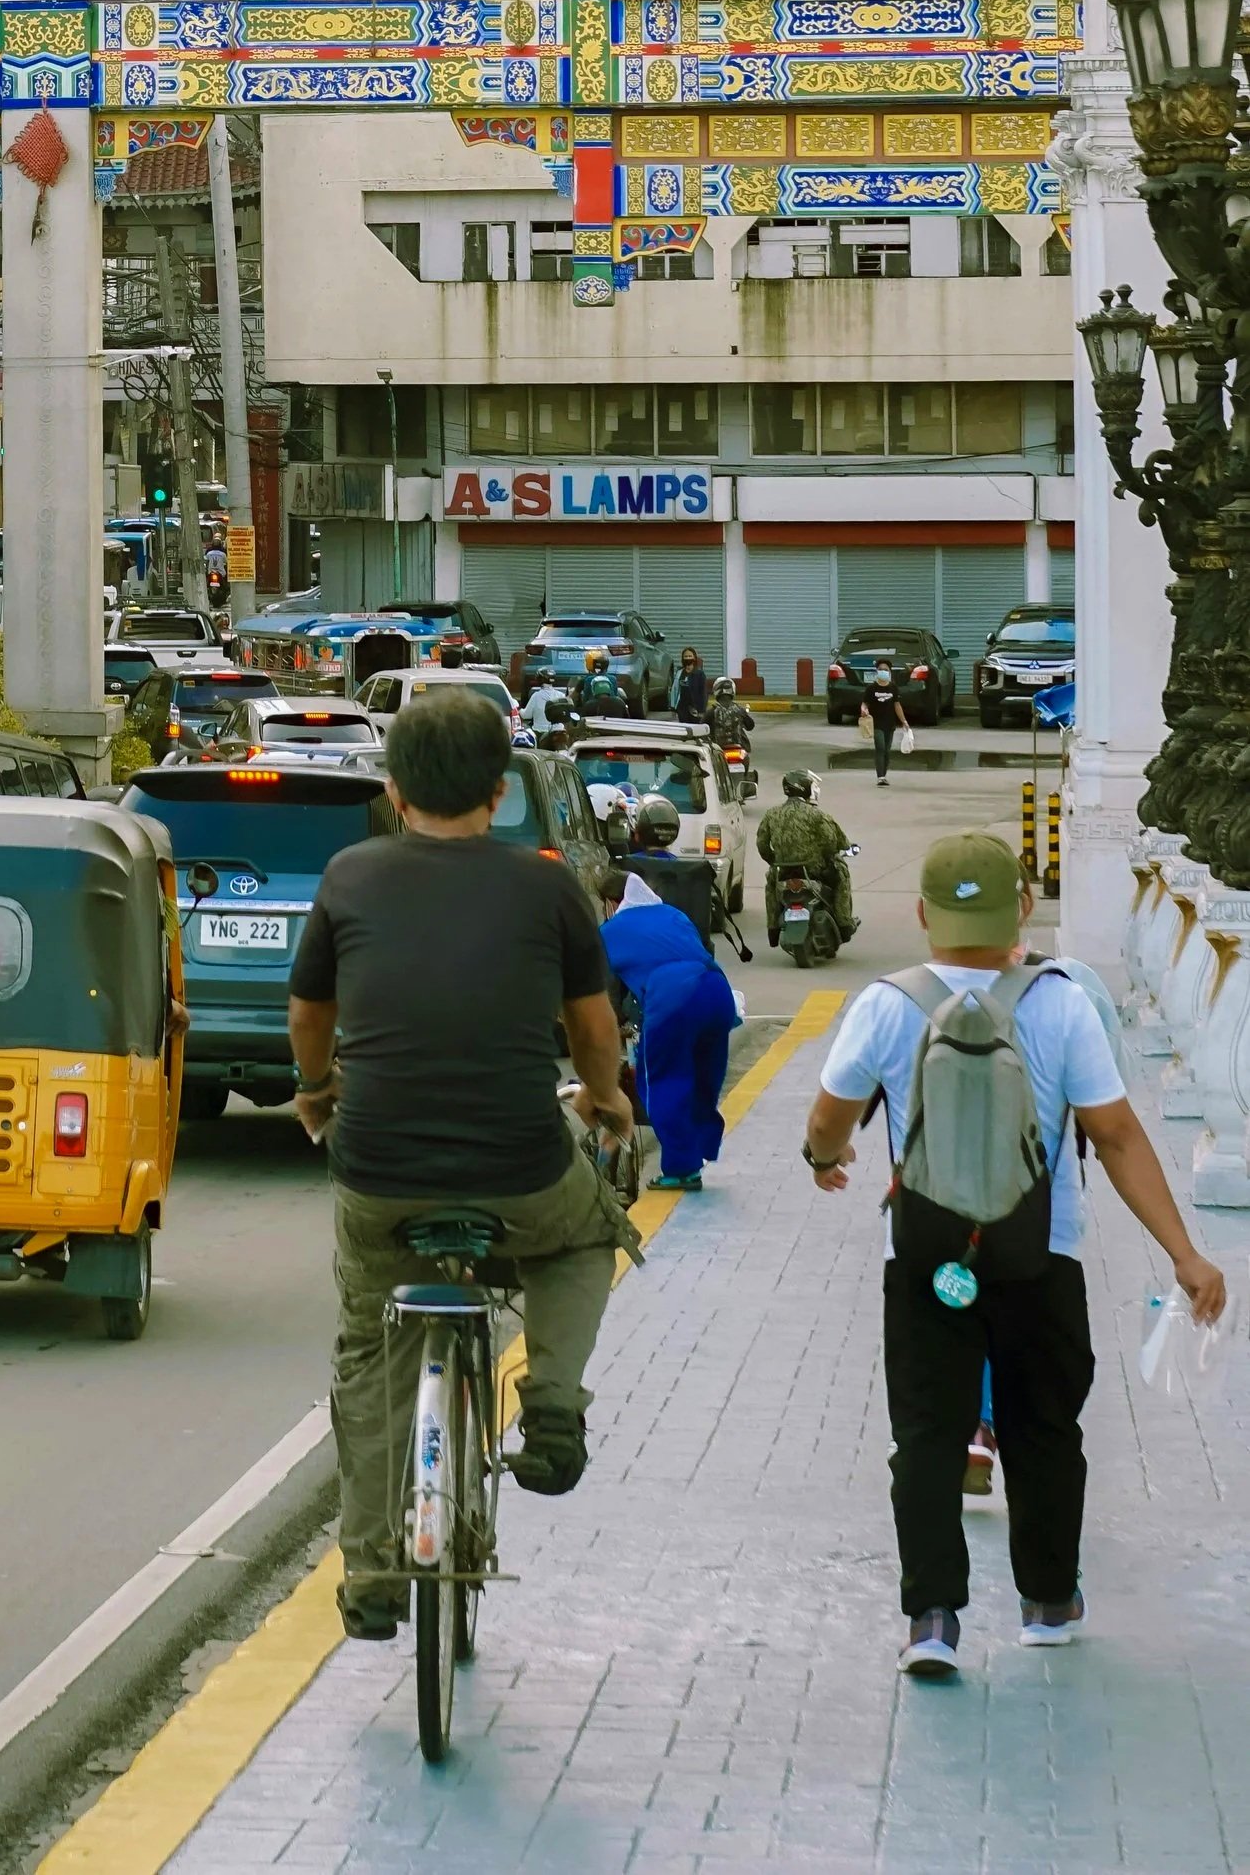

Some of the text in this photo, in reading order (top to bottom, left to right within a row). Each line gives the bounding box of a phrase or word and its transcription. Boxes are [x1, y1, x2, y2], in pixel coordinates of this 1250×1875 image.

[562, 474, 707, 515] LAMPS
[209, 920, 280, 940] YNG 222
